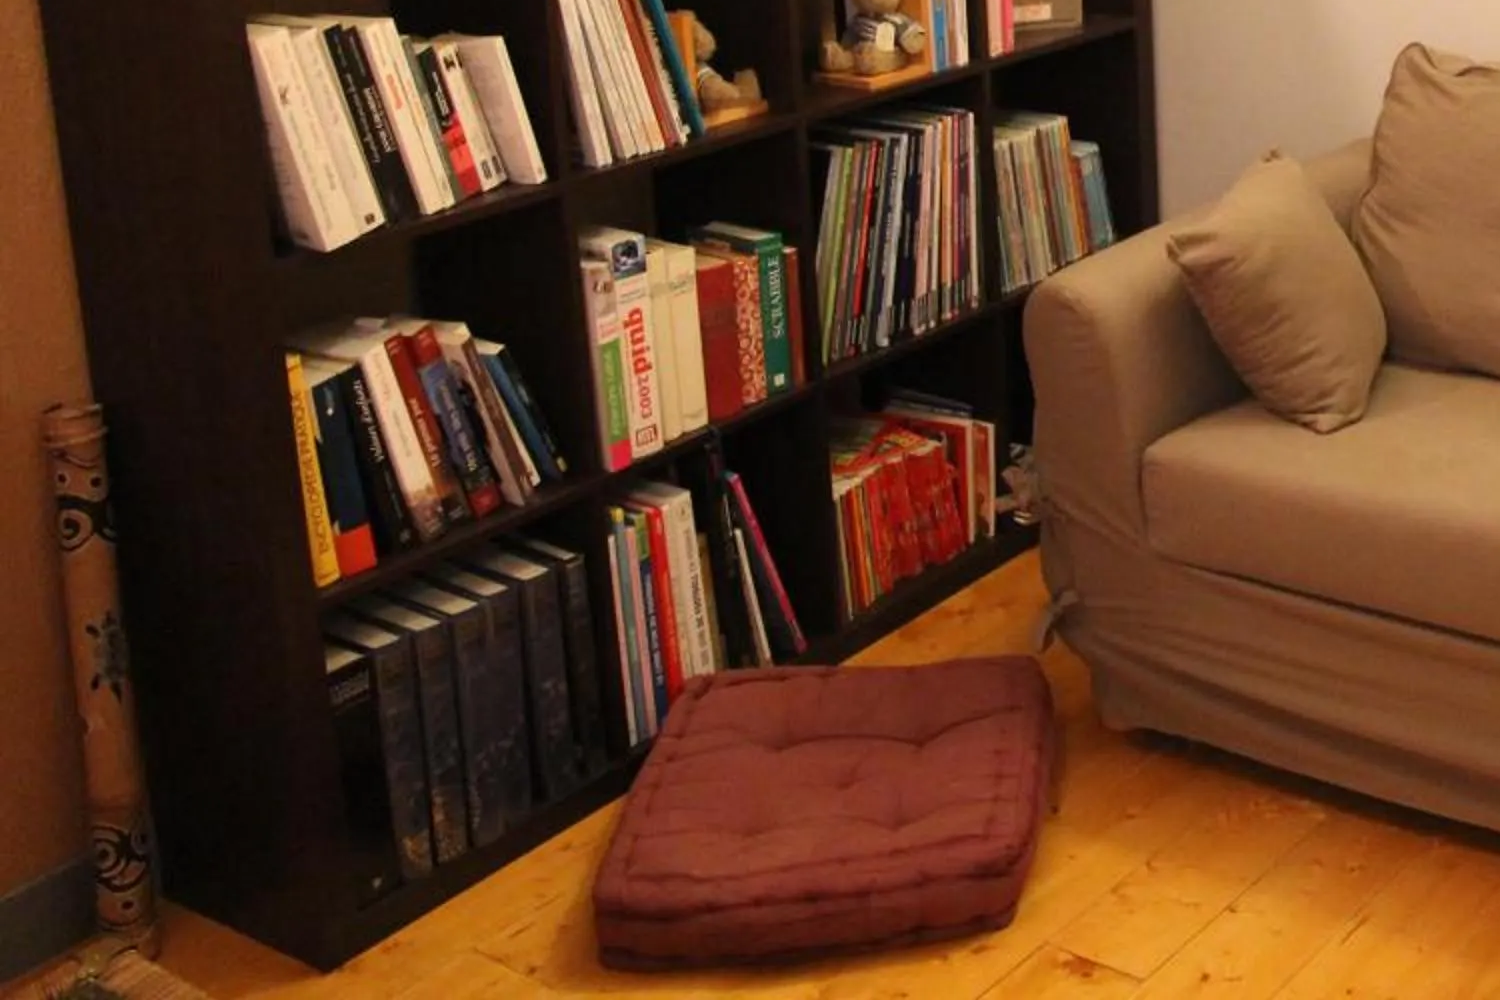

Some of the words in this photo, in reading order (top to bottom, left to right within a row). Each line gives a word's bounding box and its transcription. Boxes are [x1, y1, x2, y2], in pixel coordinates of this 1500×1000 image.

[767, 255, 785, 339] SCRABBLE
[623, 307, 652, 374] quid
[637, 374, 652, 419] 2003
